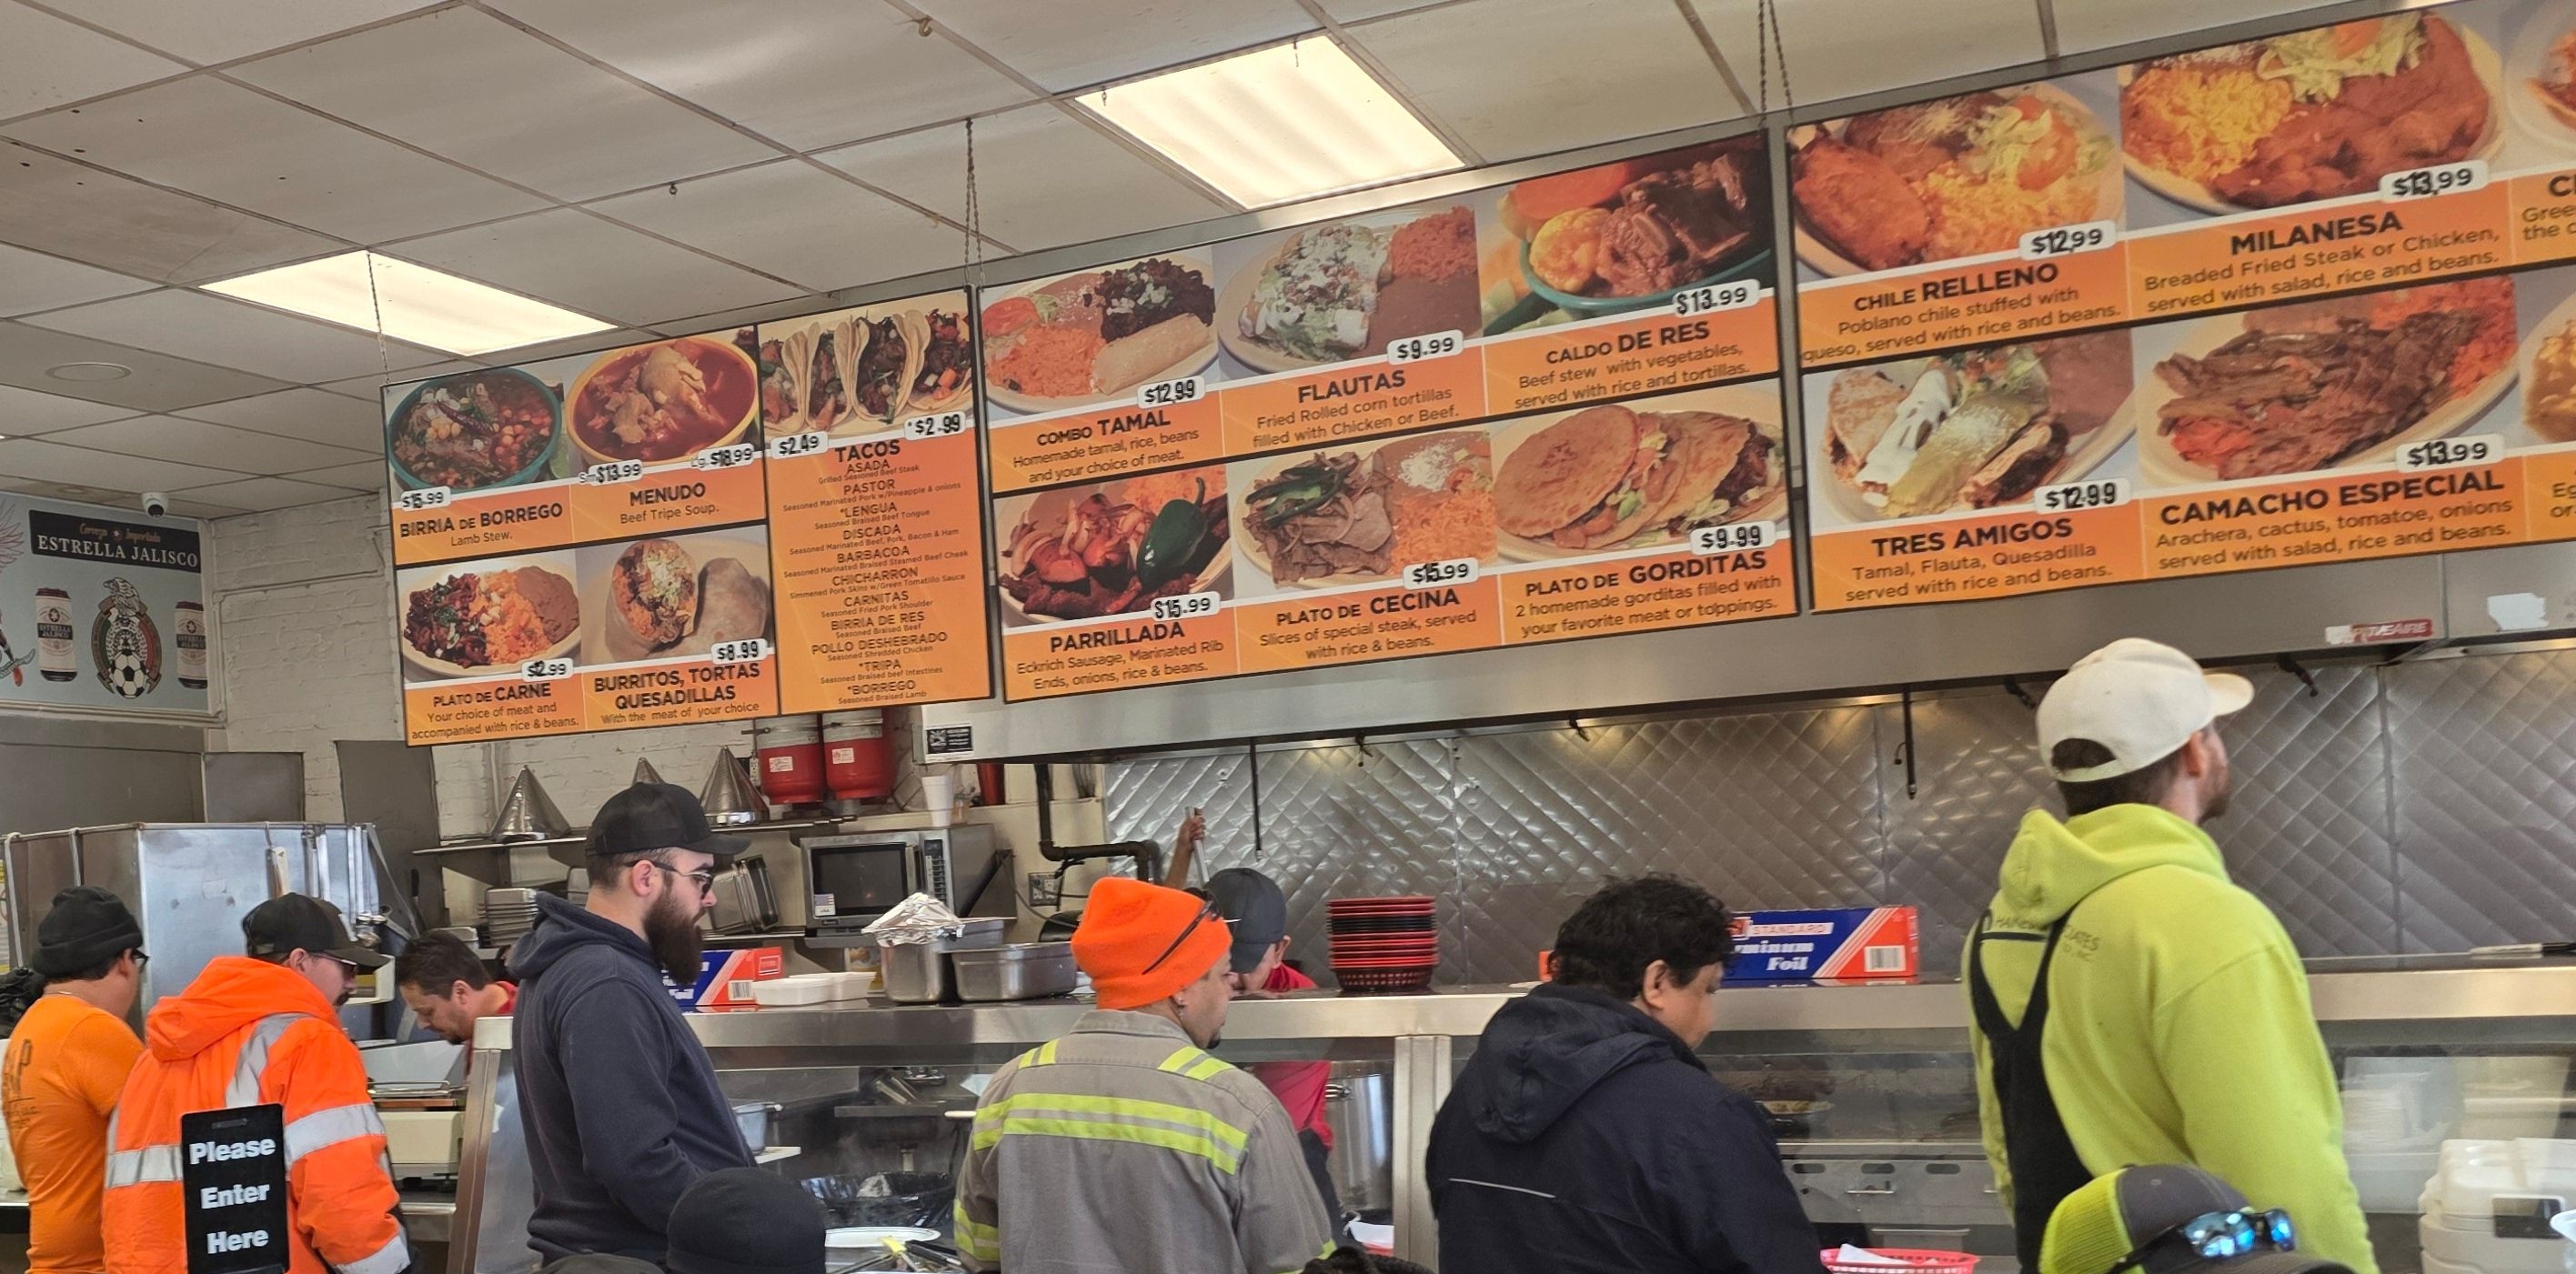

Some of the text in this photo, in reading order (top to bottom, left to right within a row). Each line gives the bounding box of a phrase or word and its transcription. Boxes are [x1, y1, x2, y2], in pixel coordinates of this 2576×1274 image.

[2230, 211, 2403, 256] MILANESA
[2521, 224, 2561, 240] the
[2145, 226, 2501, 292] Breaded Fried Steak or Chicken,
[1854, 263, 2058, 311] CHILE RELLENO
[2147, 249, 2500, 313] served with salad, rice and beans.
[1675, 287, 1747, 315] $13.99
[1837, 286, 2079, 336] Poblano chile stuffed with
[1397, 336, 1454, 360] $9.99
[1546, 321, 1710, 365] CALDO DE RES
[1519, 343, 1743, 389] Beef stew with vegetables,
[1298, 370, 1406, 404] FLAUTAS
[1257, 387, 1453, 429] Fried Rolled corn tortillas
[915, 414, 961, 436] $2.99
[1037, 410, 1171, 446] COMBO TAMAL
[1252, 405, 1459, 448] filled with Chicken or Beef.
[779, 435, 819, 456] $2.49
[835, 439, 901, 462] TACOS
[1013, 427, 1199, 468] Homemade tamal, rice, beans
[2407, 441, 2489, 468] $13.99
[596, 464, 641, 483] $13.99
[819, 464, 920, 484] Grilled Seasoned Beef Steak
[847, 459, 891, 474] ASADA
[629, 483, 706, 507] MENUDO
[844, 479, 895, 495] PASTOR
[2160, 469, 2505, 526] CAMACHO ESPECIAL
[400, 503, 563, 537] BIRRIA DE BORREGO
[620, 502, 719, 525] Beef Tripe Soup.
[815, 509, 930, 530] Seasoned Braised Beef Tongue
[2155, 498, 2512, 549] Arachera, cactus, tomatoe, onions
[450, 531, 513, 547] Lamb Stew.
[843, 525, 901, 539] DISCADA
[1701, 526, 1762, 550] $9.99
[1871, 517, 2073, 557] TRES AMIGOS
[37, 535, 197, 567] ESTRELLA JALISCO
[837, 547, 911, 563] BARBACOA
[1852, 542, 2097, 581] Tamal, Flauta, Quesadilla
[832, 567, 919, 586] CHICHARRON
[1525, 551, 1766, 597] PLATO DE GORDITAS
[844, 591, 909, 607] CARNITAS
[1154, 597, 1211, 619] $15.99
[1276, 588, 1460, 626] PLATO DE CECINA
[1515, 576, 1781, 617] 2 homemade gorditas filled with
[831, 611, 925, 630] BIRRIA DE RES
[1260, 610, 1476, 647] Slices of special steak, served
[717, 640, 759, 660] $8.99
[811, 631, 948, 655] POLLO DESHEBRADO
[1051, 622, 1185, 653] PARRILLADA
[1017, 640, 1223, 675] Eckrich Sausage, Marinated Rib
[594, 663, 760, 693] BURRITOS, TORTAS
[433, 683, 551, 707] PLATO DE CARNE
[615, 686, 736, 710] QUESADILLAS
[839, 689, 927, 705] Seasoned Braised Lamb
[428, 702, 557, 723] Your choice of meat and
[1766, 957, 1808, 970] Foil
[189, 1138, 276, 1165] Please
[200, 1182, 270, 1209] Enter
[206, 1227, 269, 1254] Here
